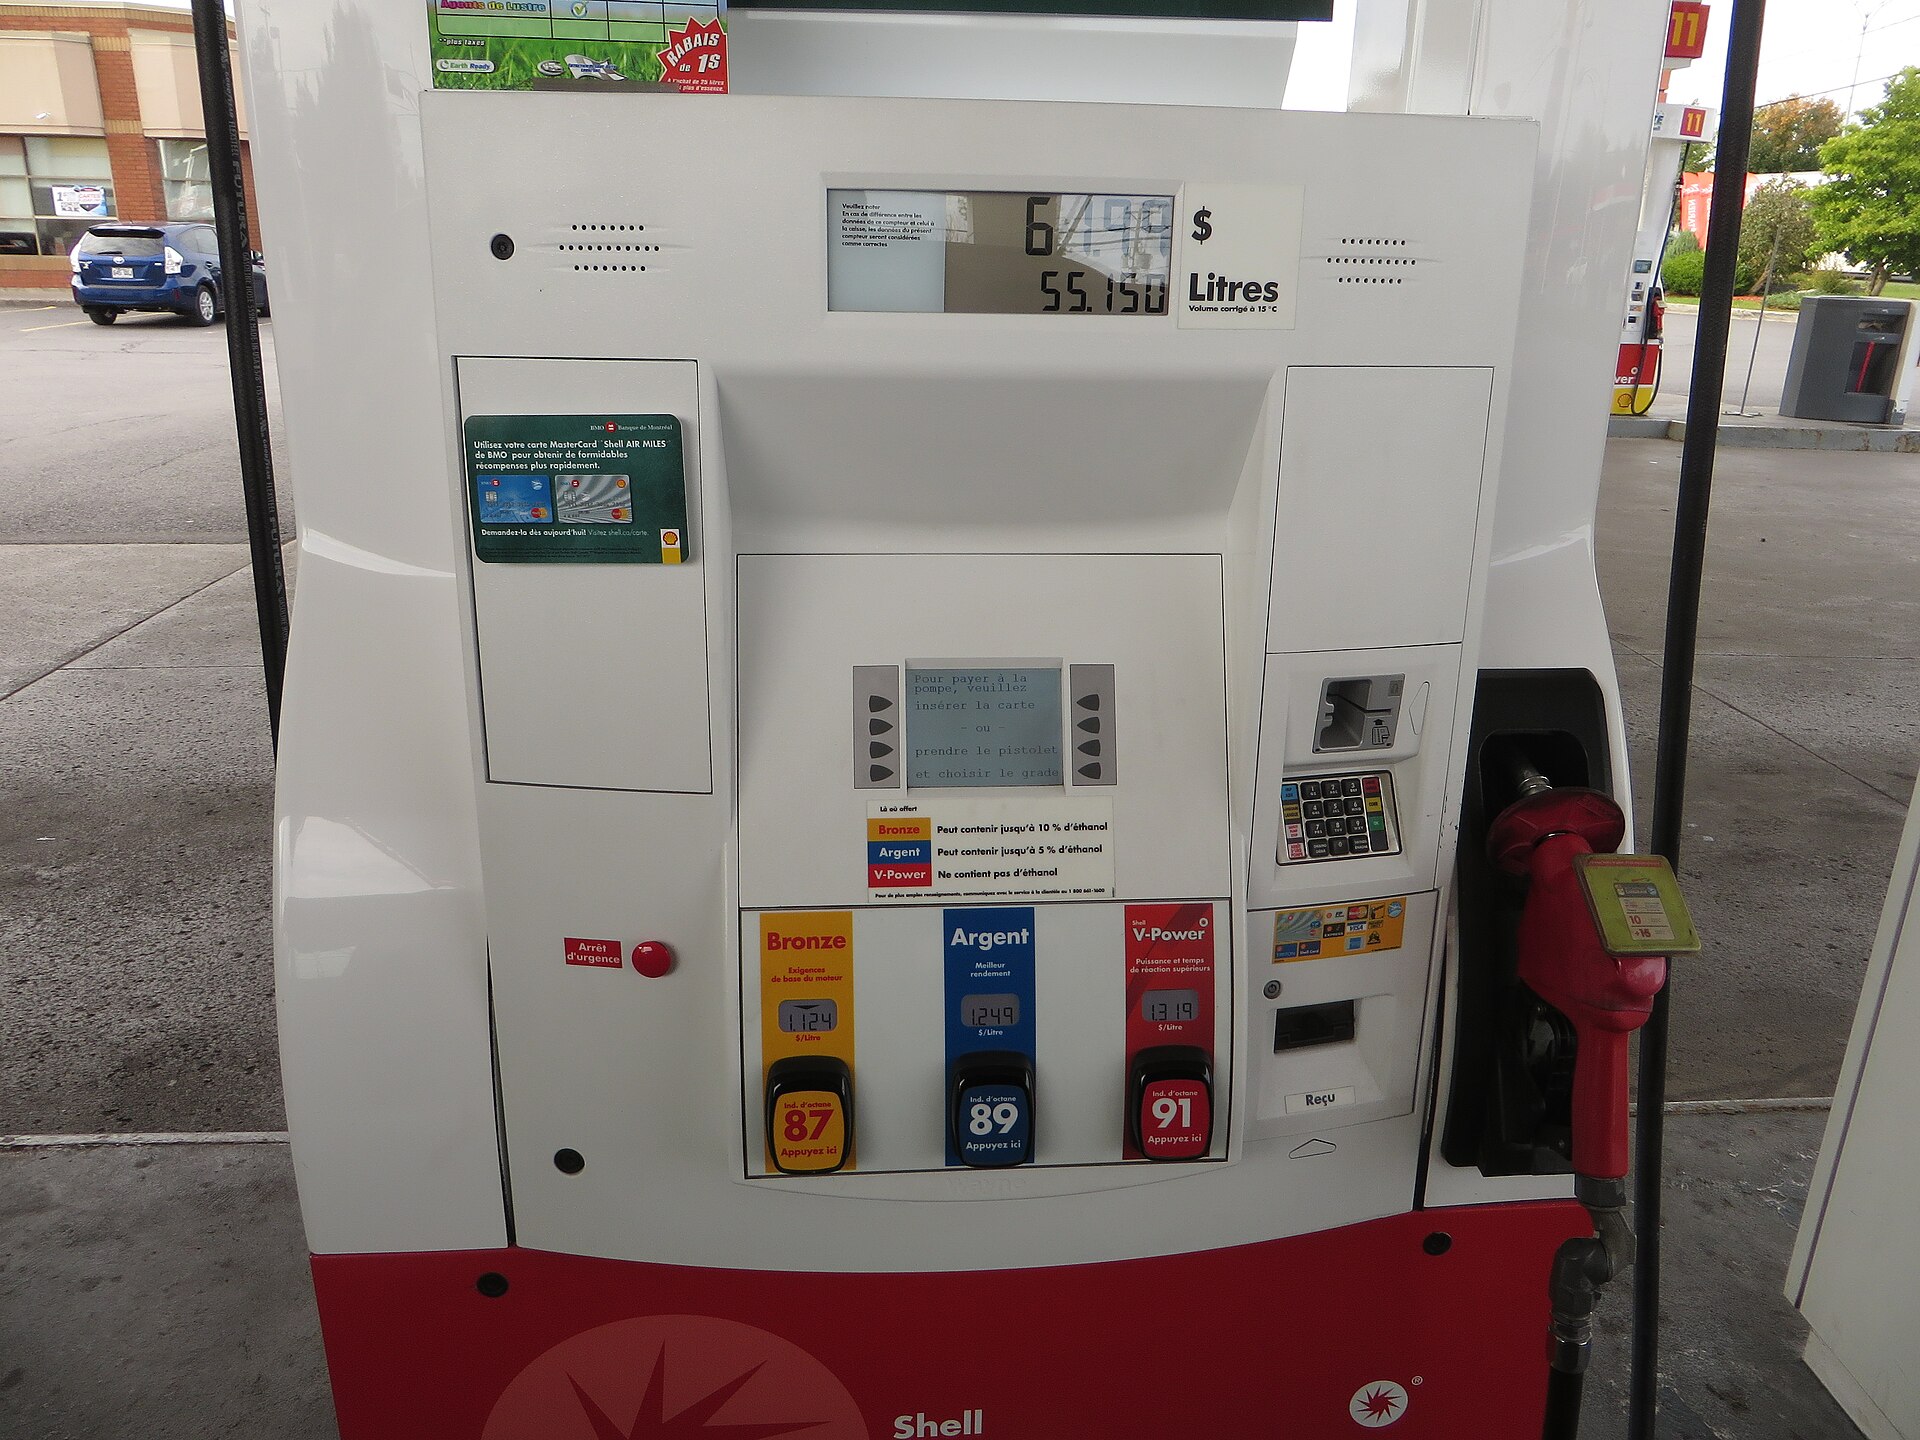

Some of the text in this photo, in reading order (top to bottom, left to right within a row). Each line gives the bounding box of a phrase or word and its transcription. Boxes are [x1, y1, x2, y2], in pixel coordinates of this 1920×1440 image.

[488, 1, 503, 10] de
[506, 1, 546, 12] Lustre
[1672, 12, 1699, 47] 11
[666, 33, 720, 66] RABAIS
[680, 54, 720, 72] de 1$
[1686, 112, 1702, 132] 11
[1191, 206, 1213, 245] $
[1041, 271, 1166, 313] 55.150
[1189, 272, 1278, 302] Litres
[1220, 304, 1248, 314] corrigé
[474, 441, 502, 449] Utilisez
[550, 440, 598, 448] MasterCard
[604, 440, 624, 448] Shell
[642, 440, 666, 448] MILES
[512, 452, 532, 460] pour
[534, 450, 563, 458] obtenir
[578, 450, 628, 458] formidables
[476, 461, 600, 470] récompenses plus rapidement.
[543, 529, 586, 538] aujourd'hui!
[914, 673, 1027, 685] Pour payer à la
[914, 684, 1027, 694] pompe, veuillez
[915, 700, 1036, 710] insérer la carte
[976, 724, 990, 732] ou
[915, 746, 1058, 758] prendre le pistolet
[916, 768, 1059, 779] et choisir le grade
[878, 822, 1108, 835] Bronze Peut contenir jusqu'à 10 % d'éthanol
[879, 844, 1102, 860] Argent Peut contenir jusqu'à 5 % d'éthanol
[874, 868, 1058, 880] V-Power Ne contient pas d'éthanol
[950, 927, 1030, 950] Argent
[1132, 927, 1205, 942] V-Power
[578, 942, 606, 952] Arrêt
[768, 932, 846, 950] Bronze
[567, 952, 620, 964] d'urgence
[1136, 958, 1172, 966] Puissance
[1182, 958, 1204, 966] temps
[788, 967, 825, 976] Exigences
[1172, 964, 1210, 974] supérieurs
[972, 1007, 1014, 1026] 1.249
[1151, 1002, 1192, 1021] 1.319
[790, 1012, 832, 1032] 1.124
[796, 1034, 821, 1042] $/Litre
[978, 1028, 1003, 1036] $/Litre
[1306, 1094, 1336, 1106] Reçu
[970, 1102, 1018, 1135] 89
[1152, 1098, 1192, 1128] 91
[784, 1110, 834, 1142] 87
[966, 1140, 1021, 1152] Appuyez ici
[1148, 1134, 1202, 1146] Appuyez ici
[780, 1146, 838, 1158] Appuyez ici
[892, 1409, 983, 1440] Shell
